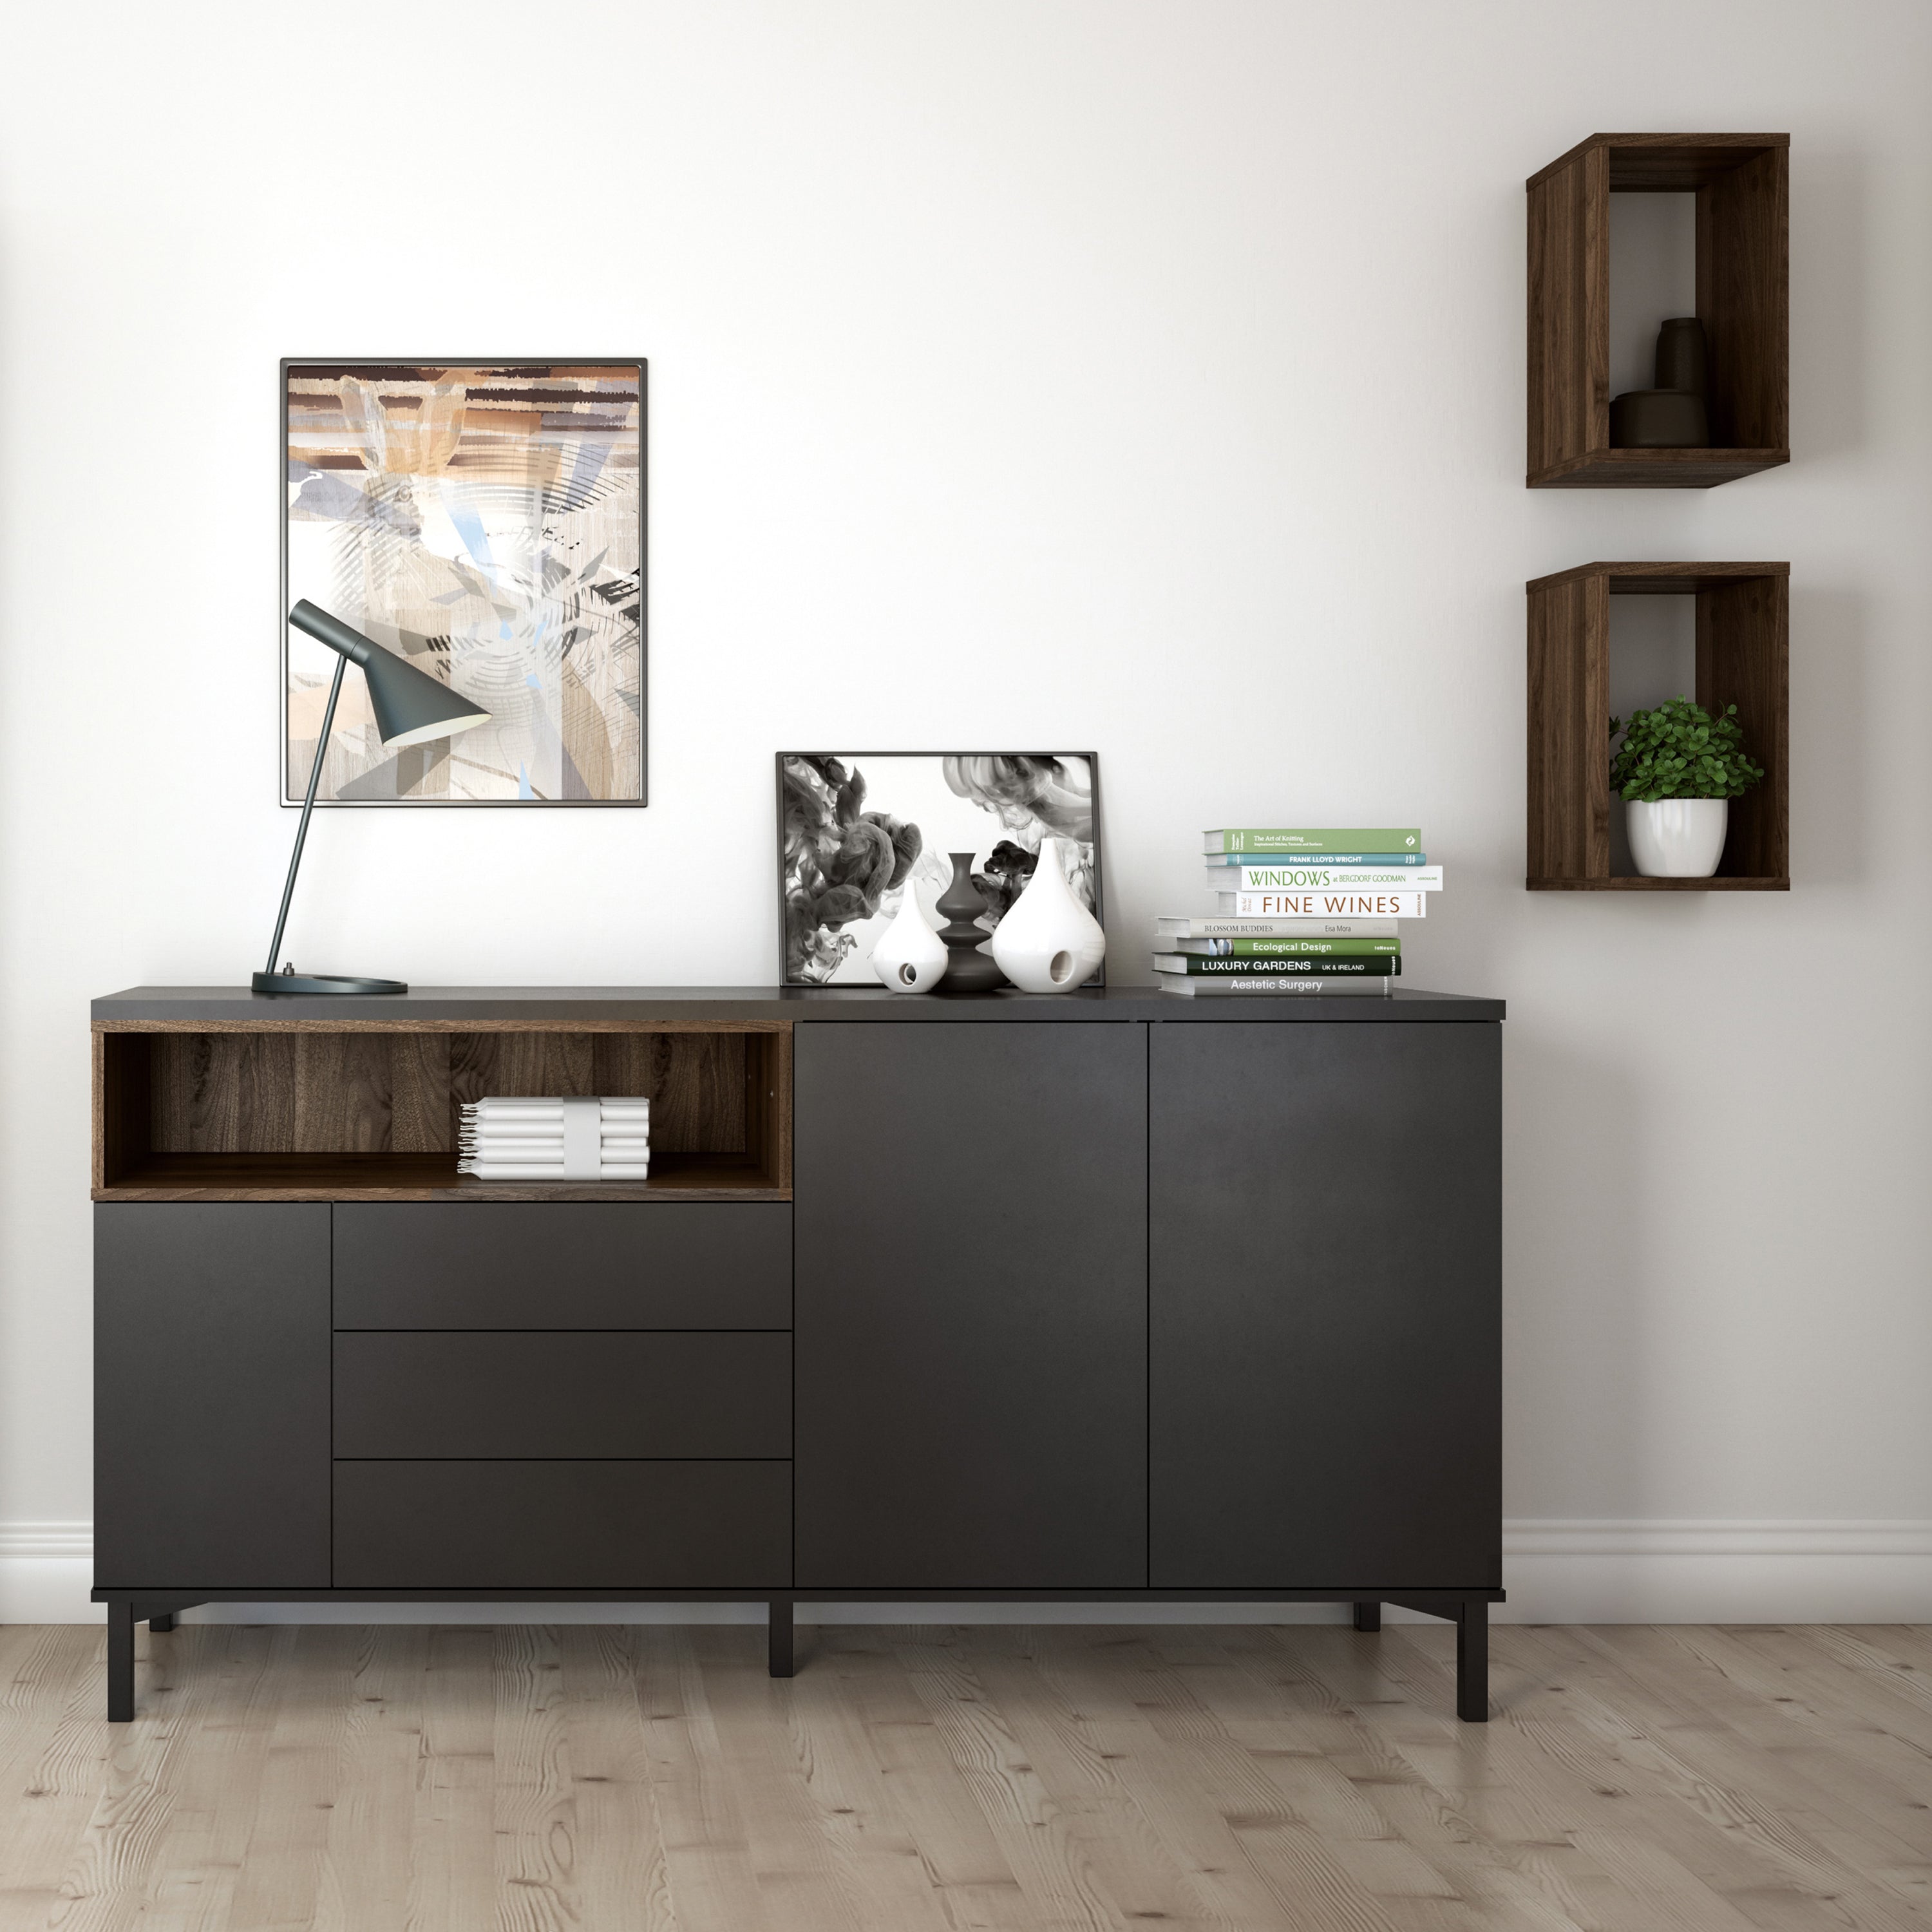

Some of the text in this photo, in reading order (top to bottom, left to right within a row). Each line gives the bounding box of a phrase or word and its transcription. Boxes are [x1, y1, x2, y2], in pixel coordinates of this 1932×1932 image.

[1248, 871, 1331, 886] WINDOWS
[1263, 896, 1400, 913] FINE WINES
[1253, 943, 1332, 953] Ecological Design
[1202, 961, 1311, 971] LUXURY GARDENS
[1231, 980, 1323, 992] Aestetic Surgery
